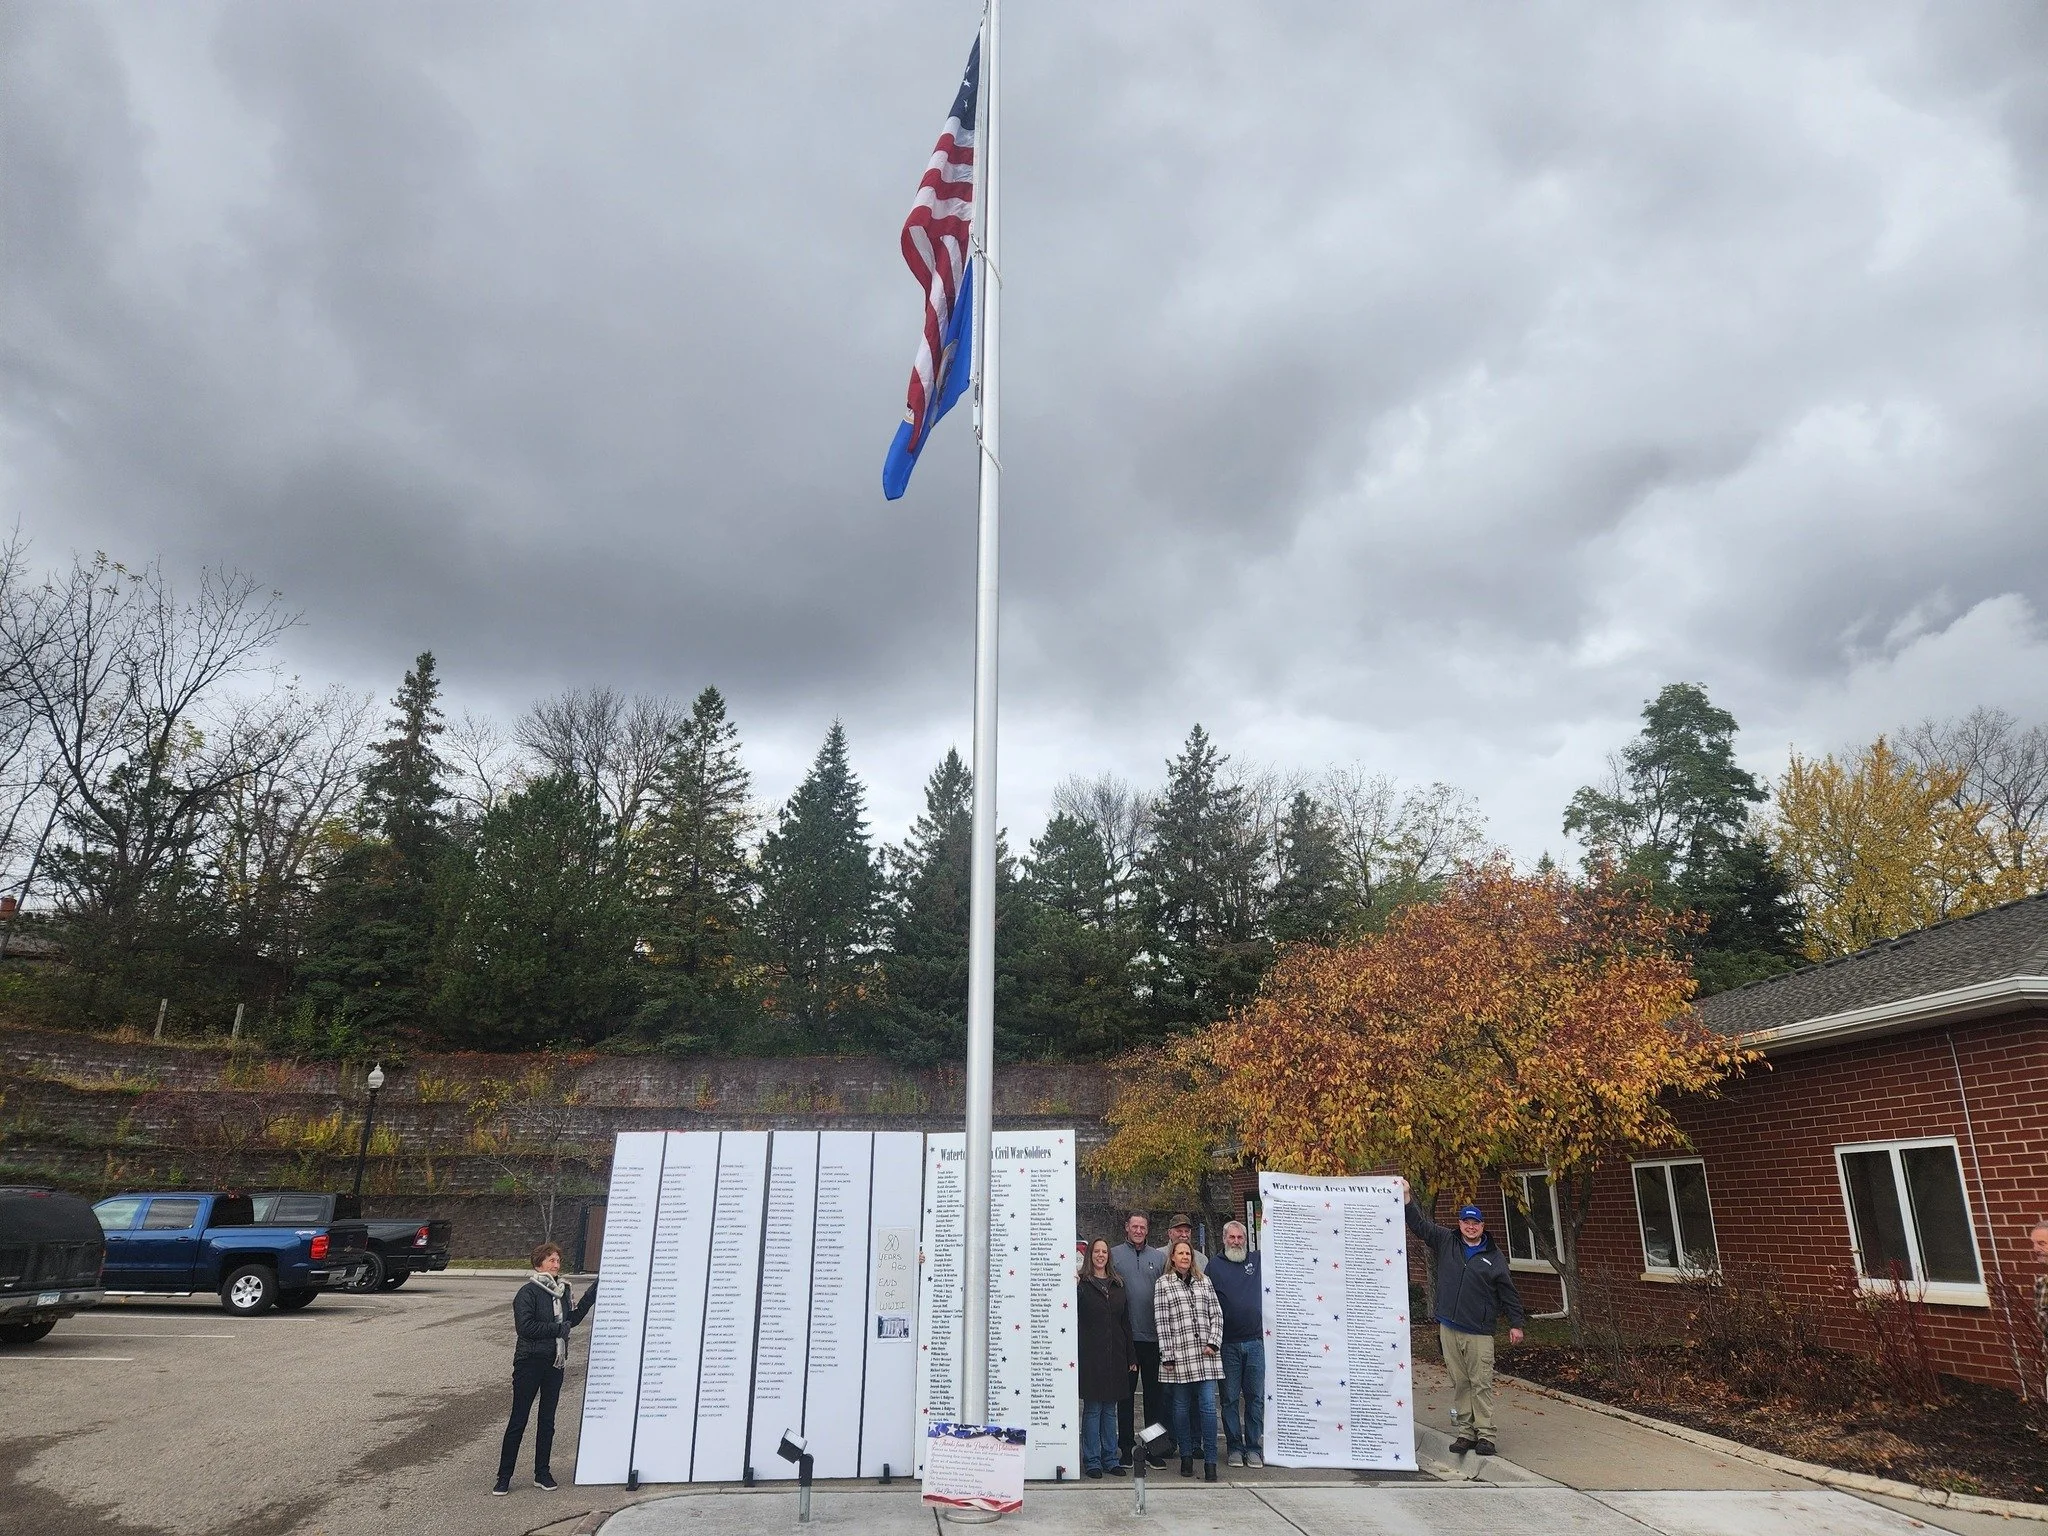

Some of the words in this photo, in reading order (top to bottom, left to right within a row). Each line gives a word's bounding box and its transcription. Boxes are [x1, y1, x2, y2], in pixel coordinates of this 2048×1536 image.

[995, 1146, 1009, 1159] Civil
[1010, 1147, 1024, 1159] War
[1024, 1146, 1051, 1159] Soldiers
[1272, 1182, 1321, 1192] Watertown
[1324, 1185, 1346, 1193] Area
[1348, 1185, 1369, 1194] WWI
[1371, 1186, 1392, 1194] Vets
[884, 1234, 899, 1251] 80
[878, 1278, 897, 1287] END
[880, 1302, 905, 1311] WWII
